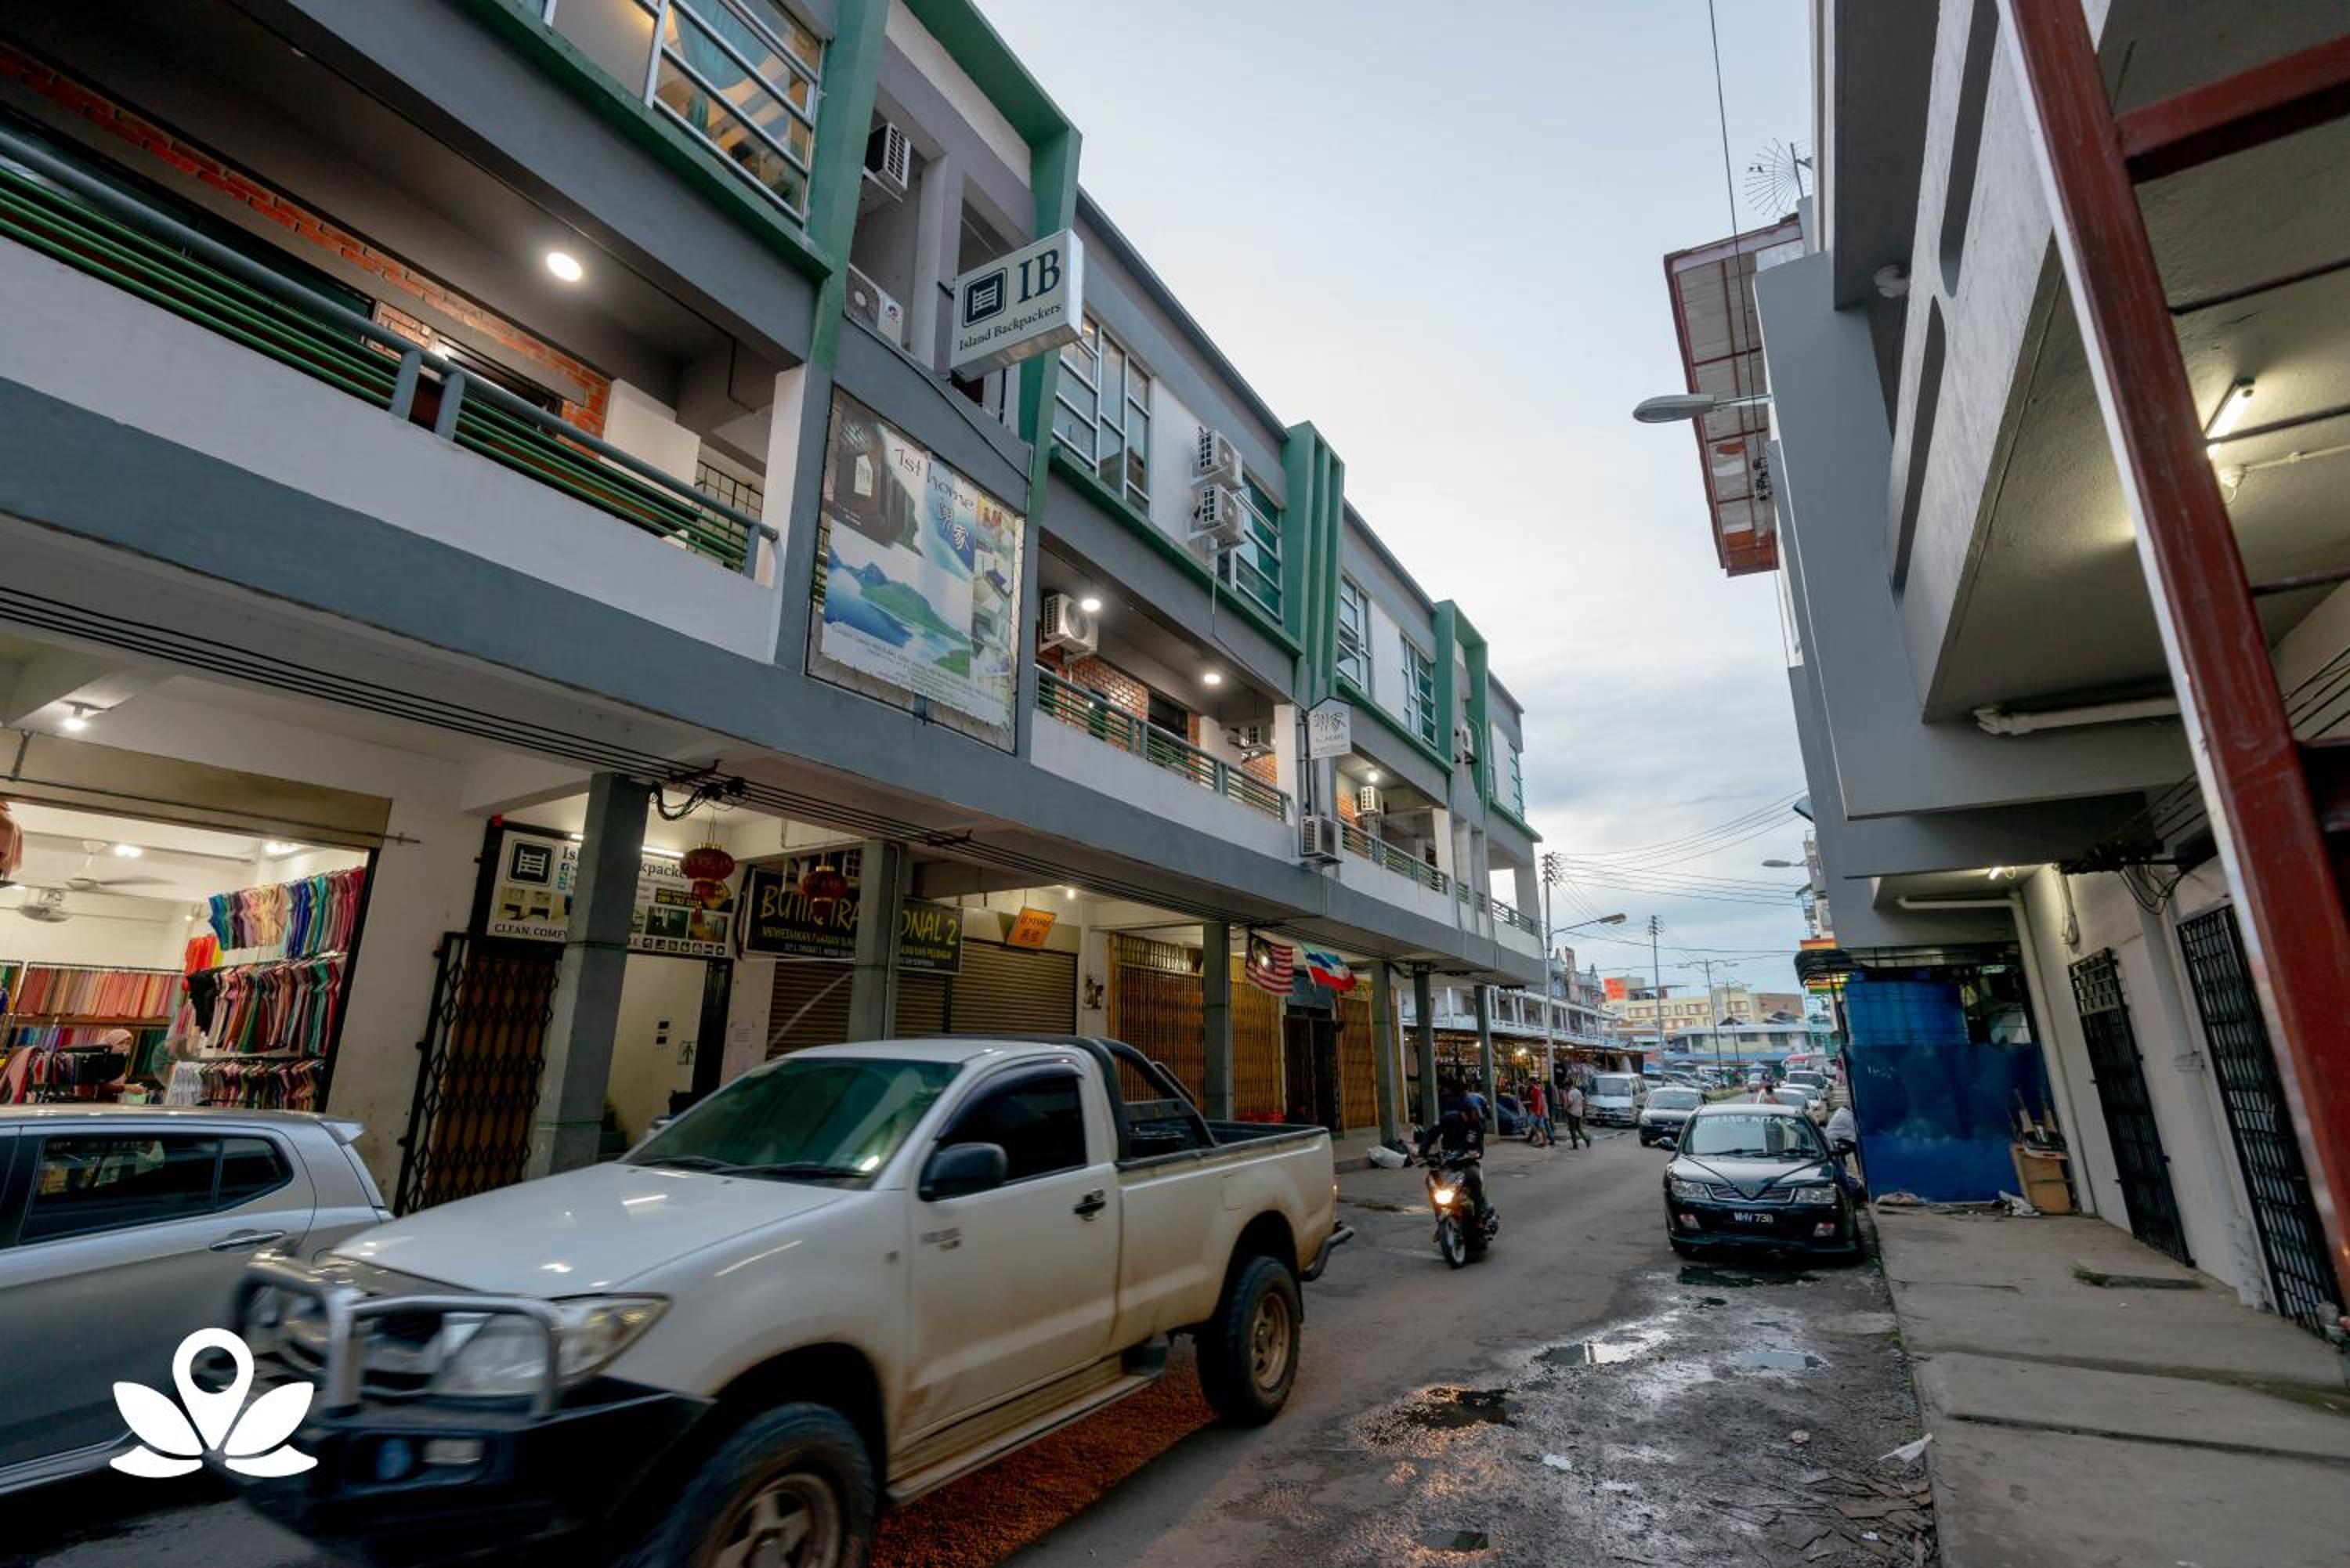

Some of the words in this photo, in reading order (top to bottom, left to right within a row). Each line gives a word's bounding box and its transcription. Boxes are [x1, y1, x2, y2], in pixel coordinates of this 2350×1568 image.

[1018, 249, 1061, 303] IB
[960, 329, 991, 351] Island
[993, 303, 1061, 338] Backpackers
